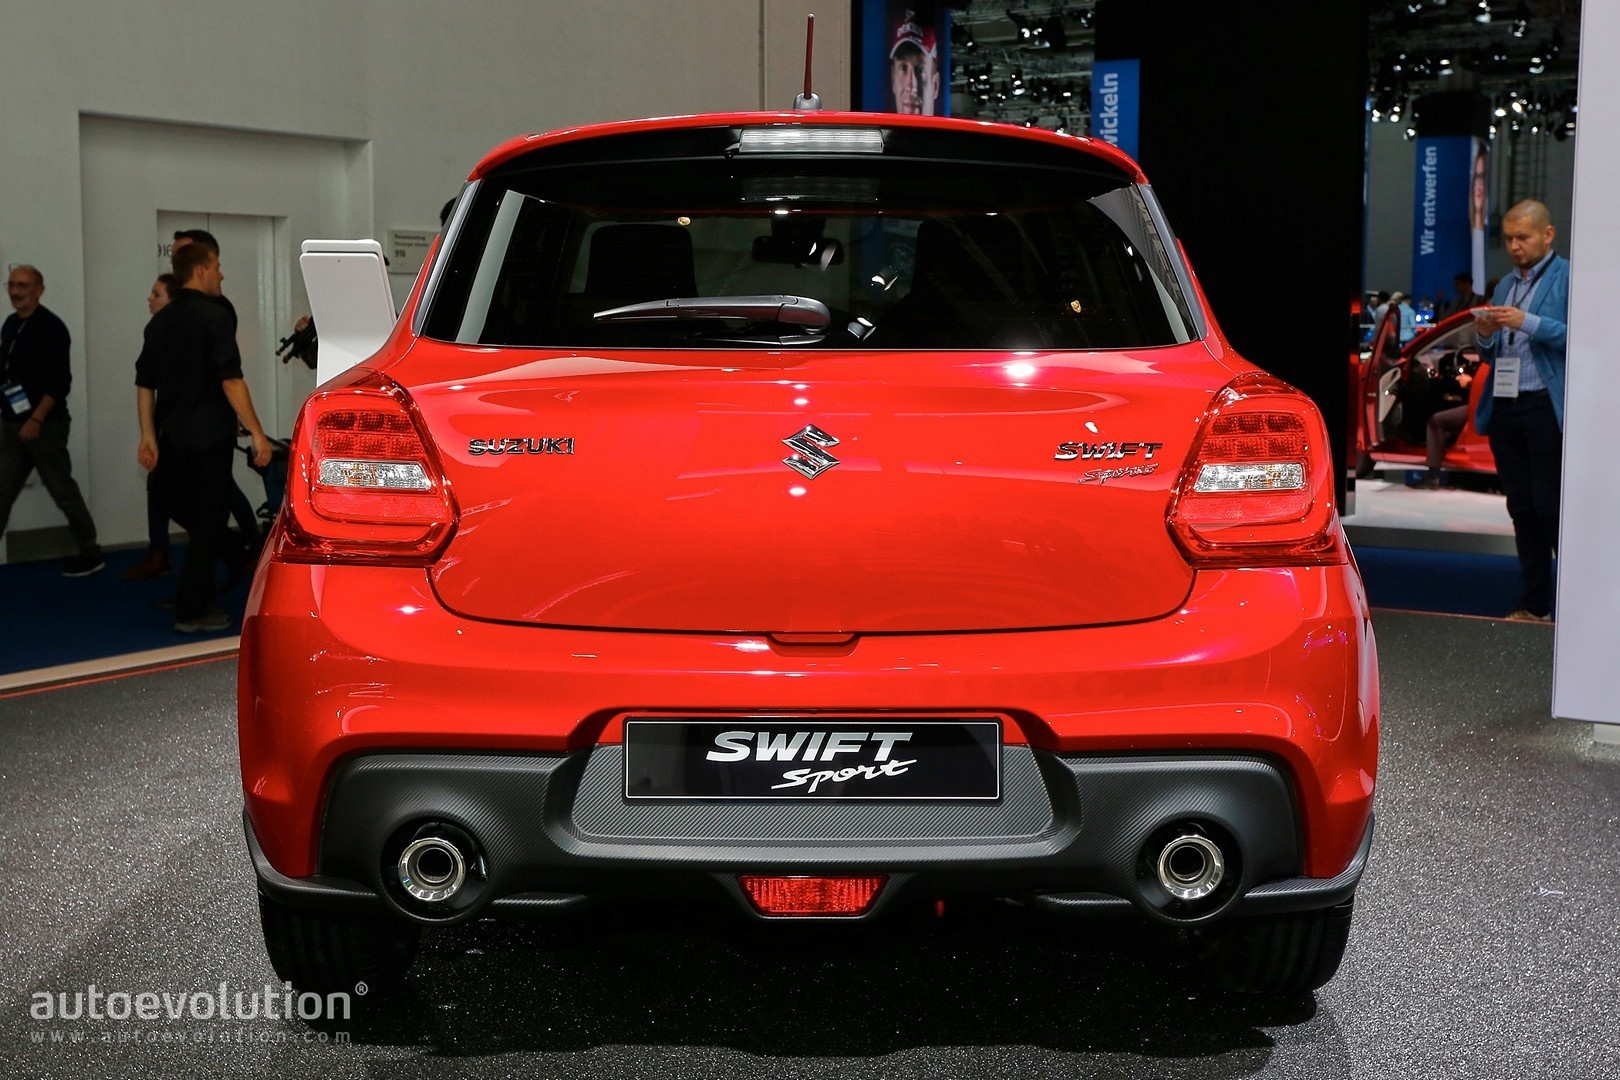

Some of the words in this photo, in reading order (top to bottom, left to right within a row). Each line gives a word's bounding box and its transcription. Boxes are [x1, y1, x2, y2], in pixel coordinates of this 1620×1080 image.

[1422, 146, 1438, 227] entwerfen
[1420, 229, 1435, 255] Wir
[468, 437, 575, 455] SUZUKI
[1054, 441, 1163, 460] SWIFT
[1078, 462, 1159, 485] Sport
[705, 731, 913, 762] SWIFT
[771, 759, 917, 794] Sport
